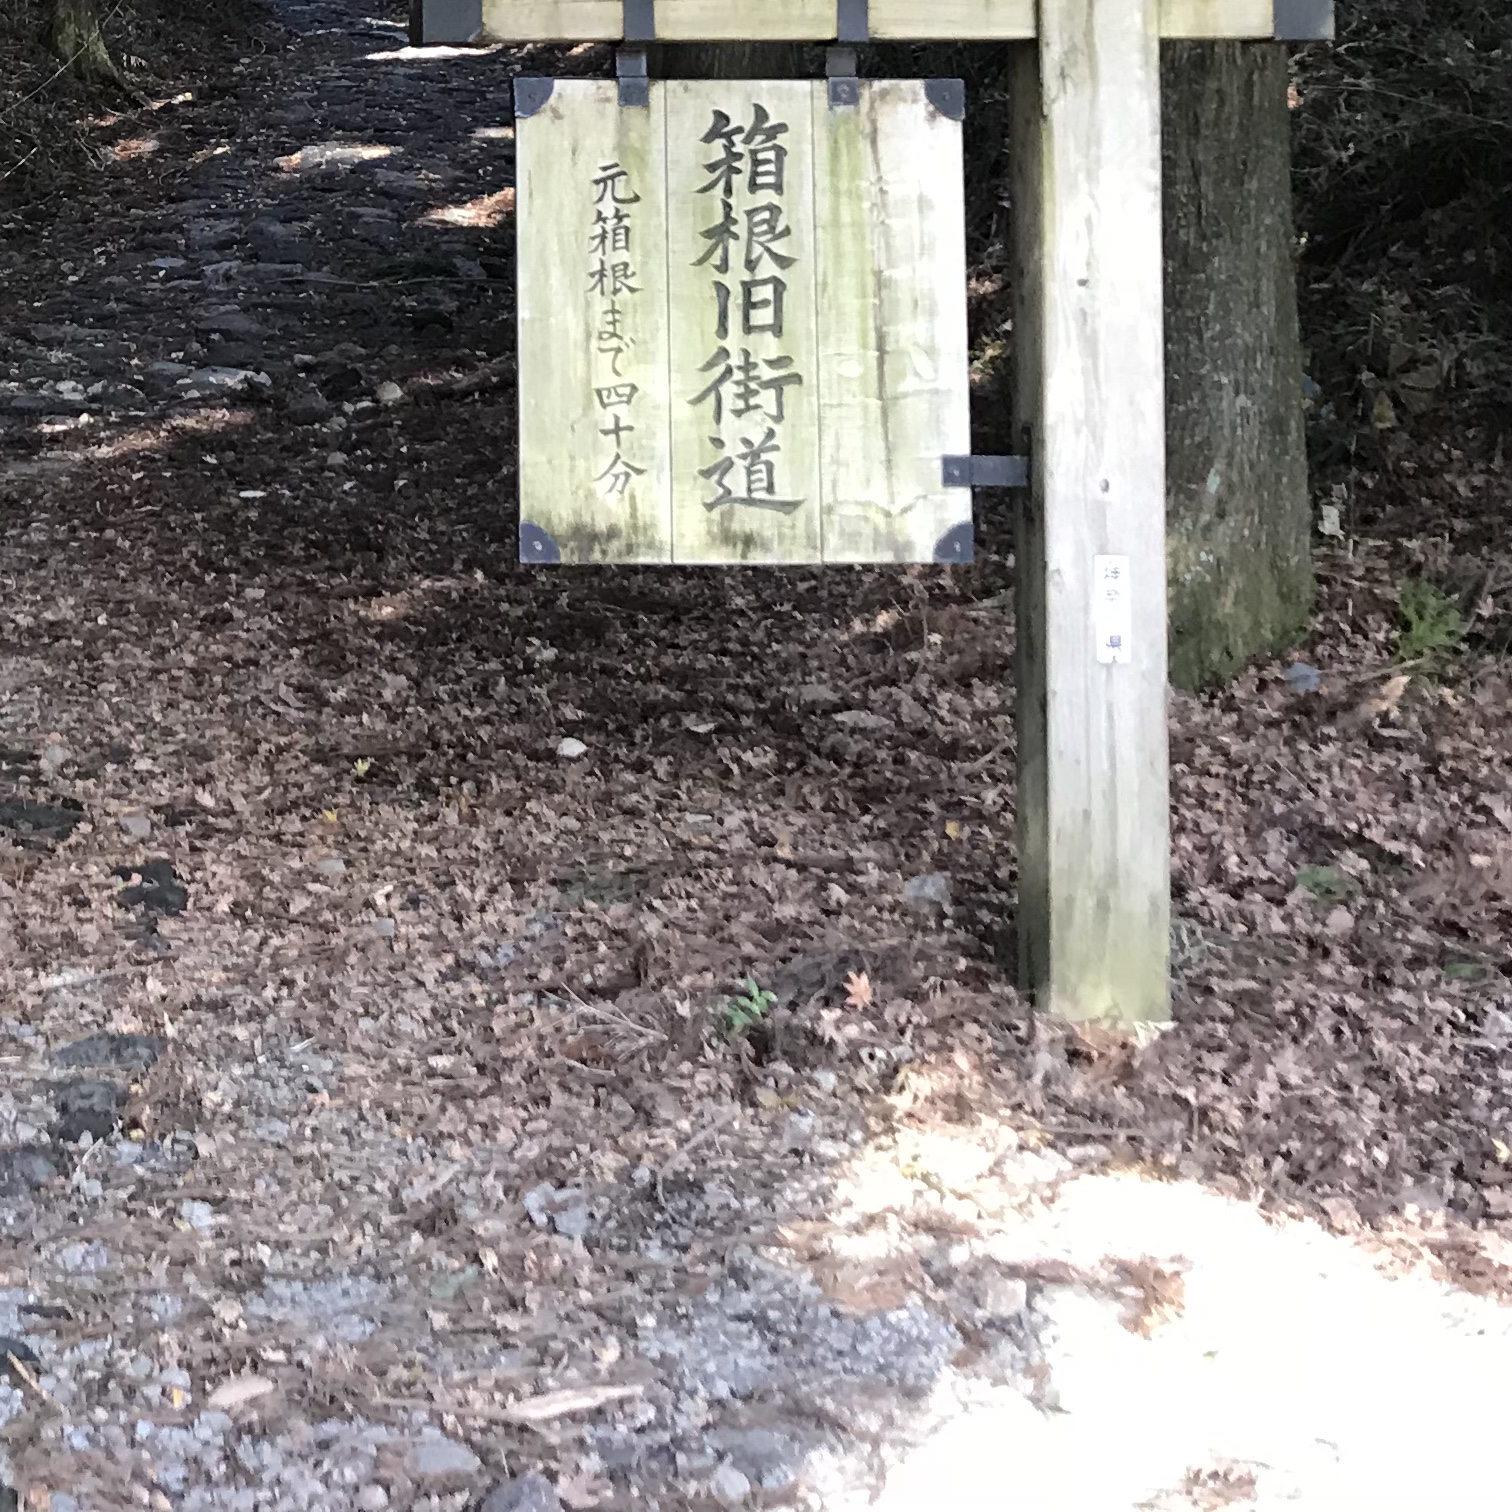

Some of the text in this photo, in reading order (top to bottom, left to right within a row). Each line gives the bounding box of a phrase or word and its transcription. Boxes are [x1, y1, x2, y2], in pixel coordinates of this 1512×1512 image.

[587, 162, 648, 497] 元箱根まで四十分
[687, 103, 806, 516] 箱根旧街道
